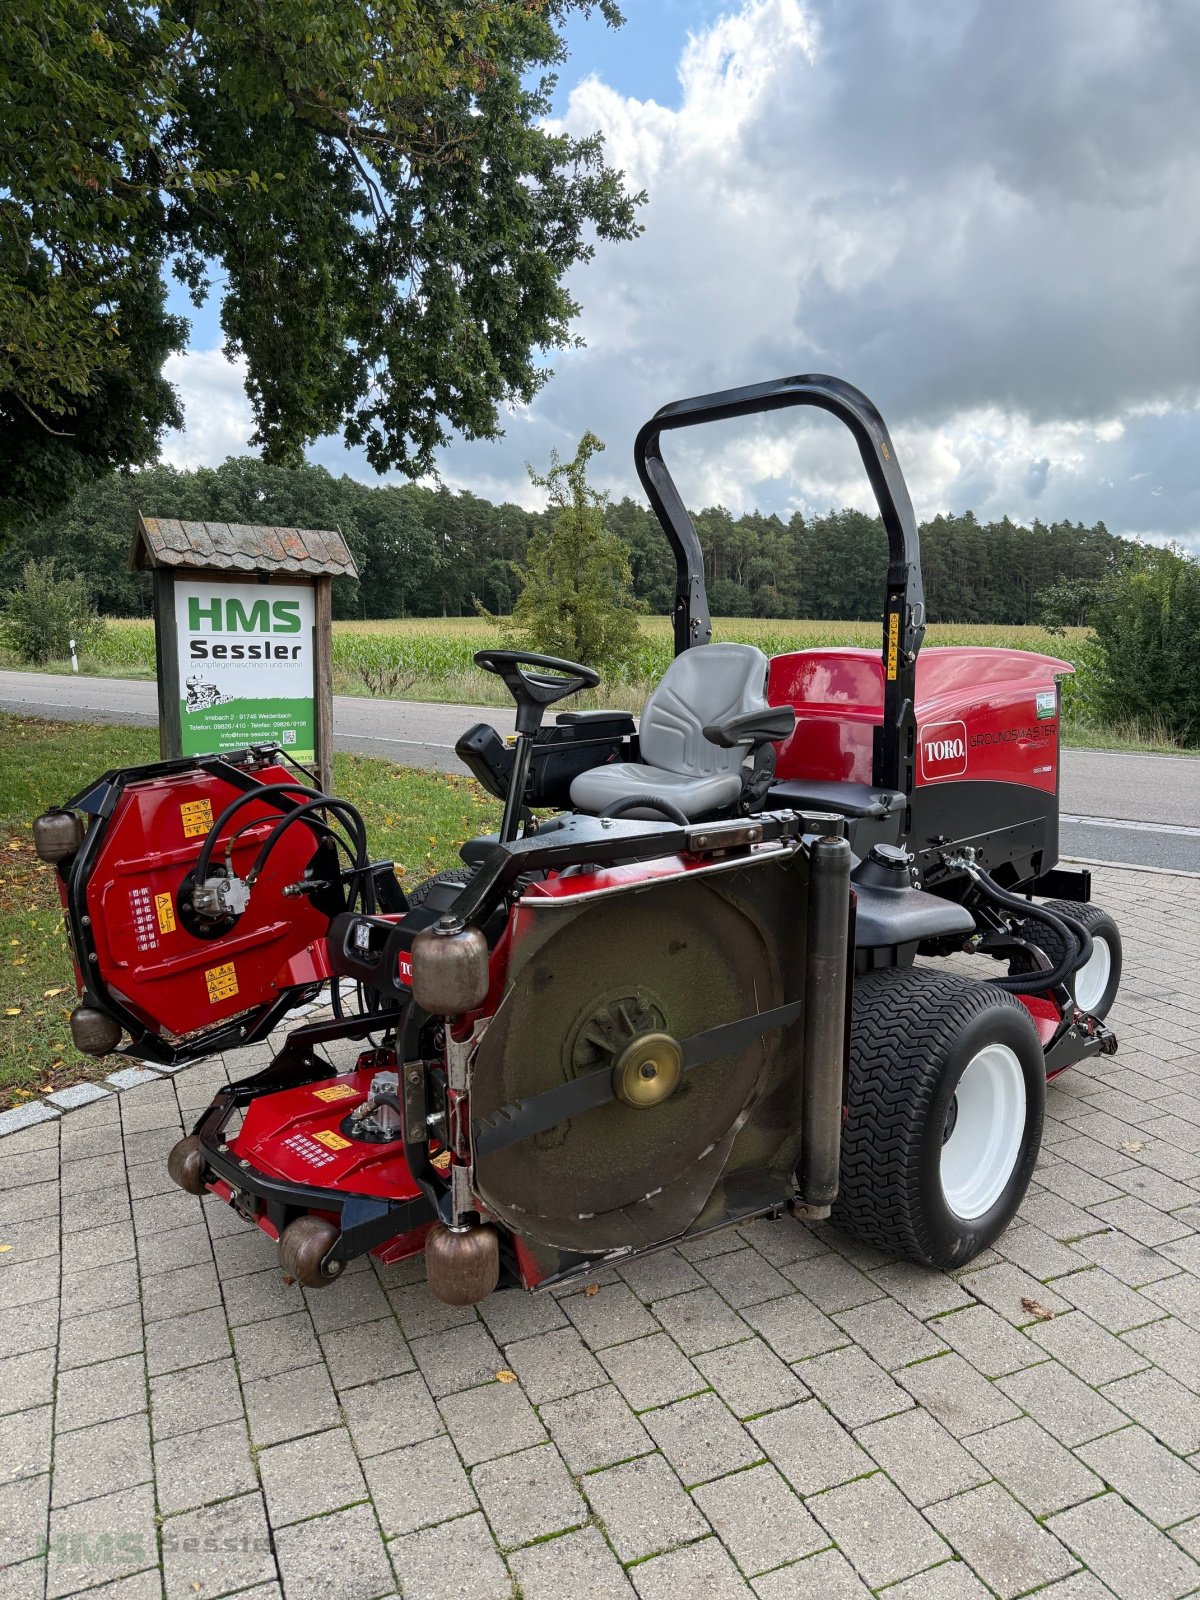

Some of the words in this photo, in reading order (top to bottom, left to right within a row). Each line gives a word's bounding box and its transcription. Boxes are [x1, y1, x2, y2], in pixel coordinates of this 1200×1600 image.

[188, 597, 301, 633] HMS
[190, 640, 301, 660] Sessler
[970, 724, 1056, 747] GROUNDSMASTER
